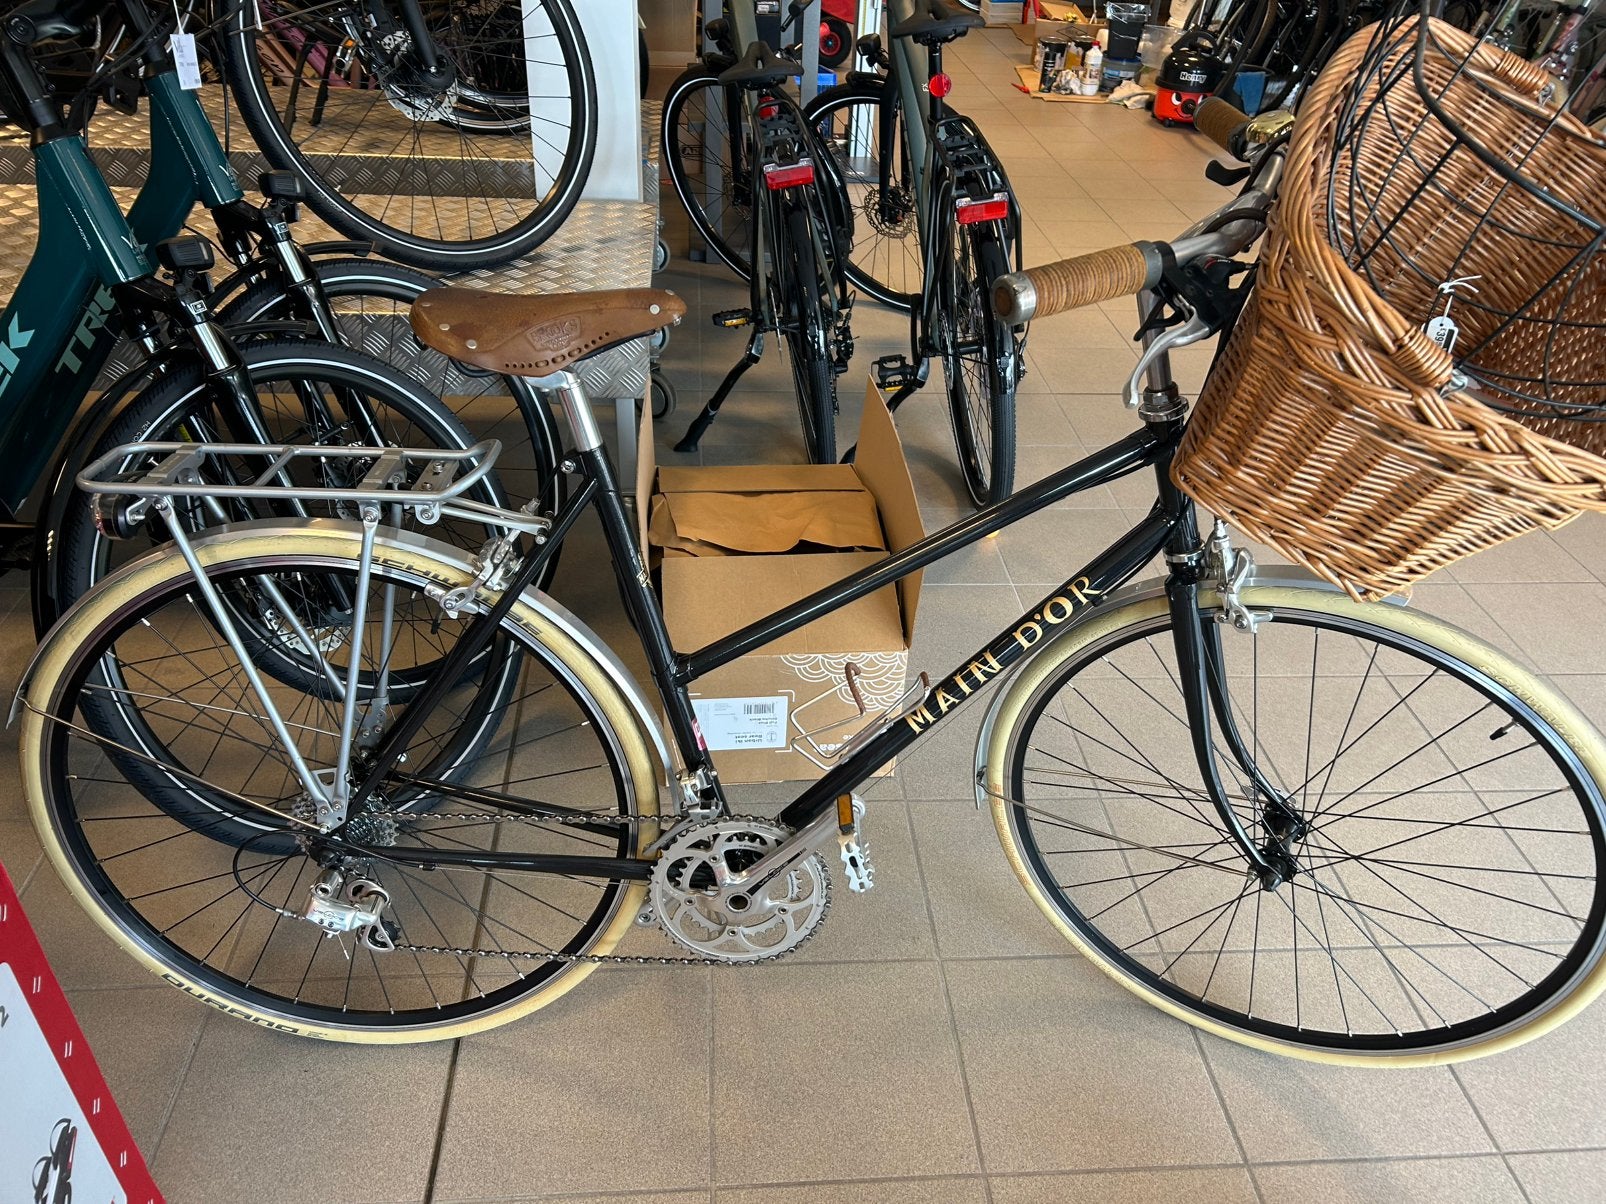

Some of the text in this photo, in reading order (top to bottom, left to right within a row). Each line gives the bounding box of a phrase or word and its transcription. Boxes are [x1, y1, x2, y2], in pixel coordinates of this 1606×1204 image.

[1180, 71, 1207, 84] Henry
[55, 283, 116, 374] TRE
[904, 649, 1004, 735] MAIN
[161, 973, 300, 1034] DURANO
